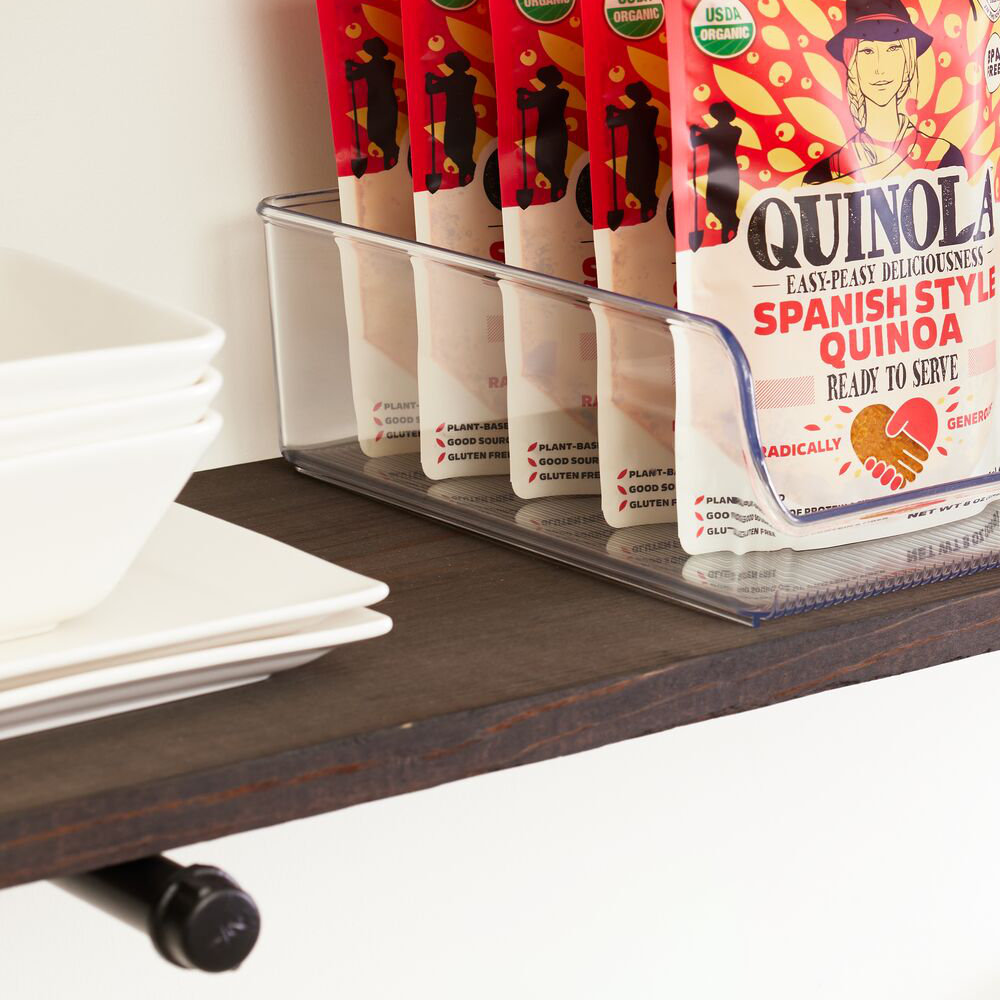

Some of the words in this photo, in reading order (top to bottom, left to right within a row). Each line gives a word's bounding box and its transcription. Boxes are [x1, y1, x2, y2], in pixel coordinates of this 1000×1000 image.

[613, 6, 660, 23] ORGANIC
[705, 6, 742, 22] USDA
[699, 25, 750, 41] ORGANIC
[748, 170, 994, 270] QUINOLA
[786, 264, 877, 295] EASY-PEASY
[881, 247, 984, 282] DELICIOUSNESS
[753, 282, 907, 336] SPANISH
[914, 265, 996, 314] STYLE
[819, 313, 963, 369] QUINOA
[827, 374, 879, 402] READY
[885, 365, 907, 392] TO
[912, 353, 960, 387] SERVE
[385, 416, 414, 425] GOOD
[447, 437, 477, 447] GOOD
[447, 452, 487, 461] GLUTEN
[538, 456, 569, 466] GOOD
[539, 471, 579, 481] GLUTEN
[629, 484, 659, 494] GOOD
[629, 499, 669, 509] GLUTEN
[907, 508, 937, 520] NET
[940, 502, 961, 513] WT
[972, 497, 987, 505] OZ
